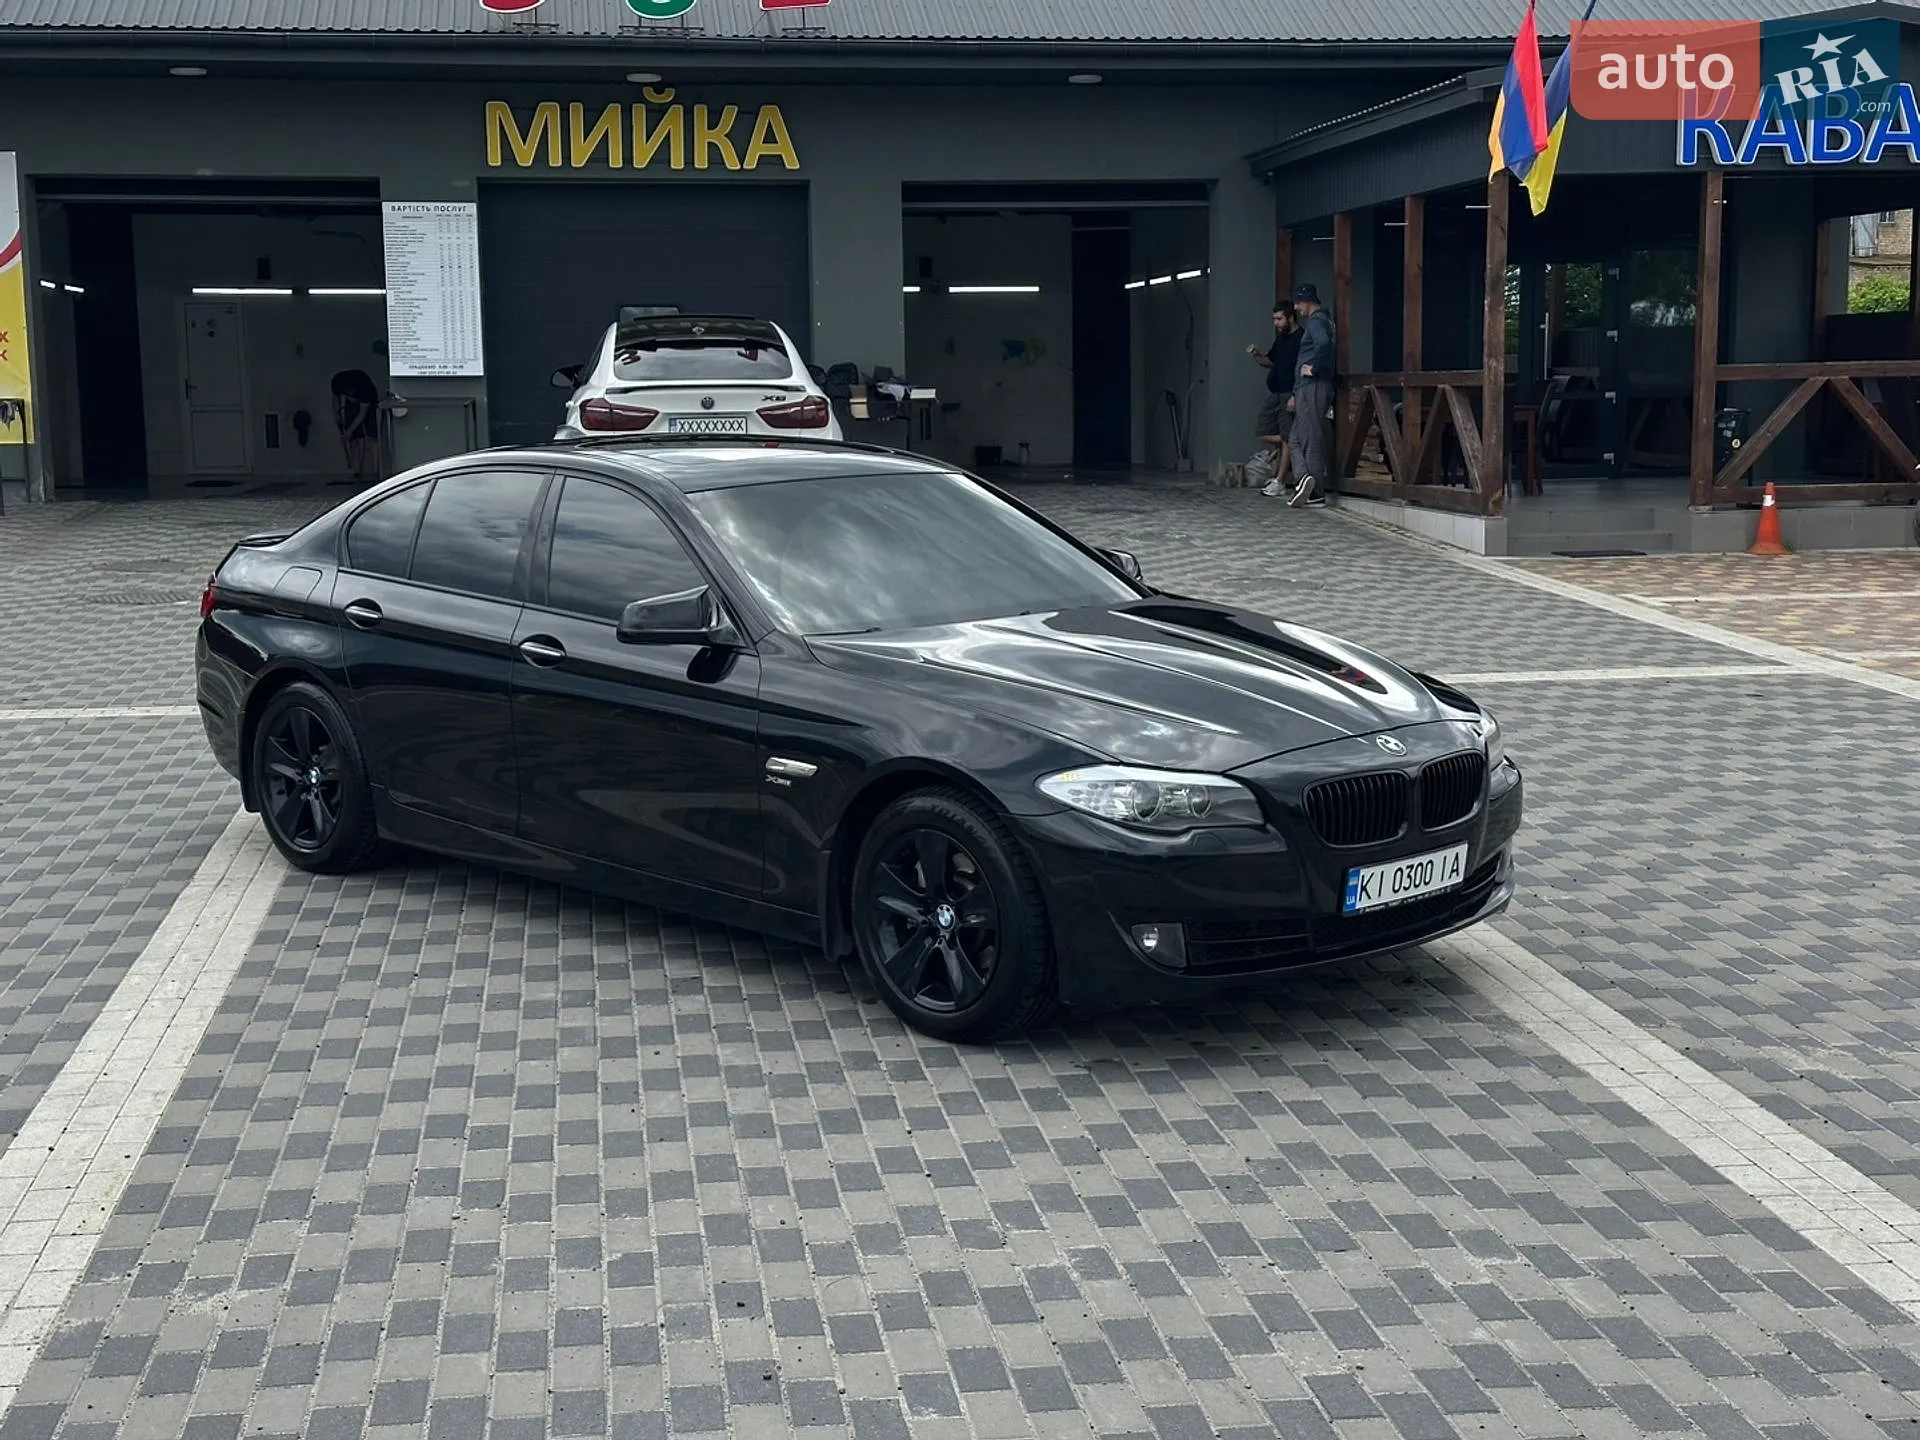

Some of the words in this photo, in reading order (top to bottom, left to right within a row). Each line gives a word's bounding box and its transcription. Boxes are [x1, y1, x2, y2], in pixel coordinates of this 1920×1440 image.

[485, 86, 800, 171] МИЙКА
[1358, 870, 1385, 902] KI
[1392, 859, 1434, 894] 0300
[1440, 852, 1460, 882] IA
